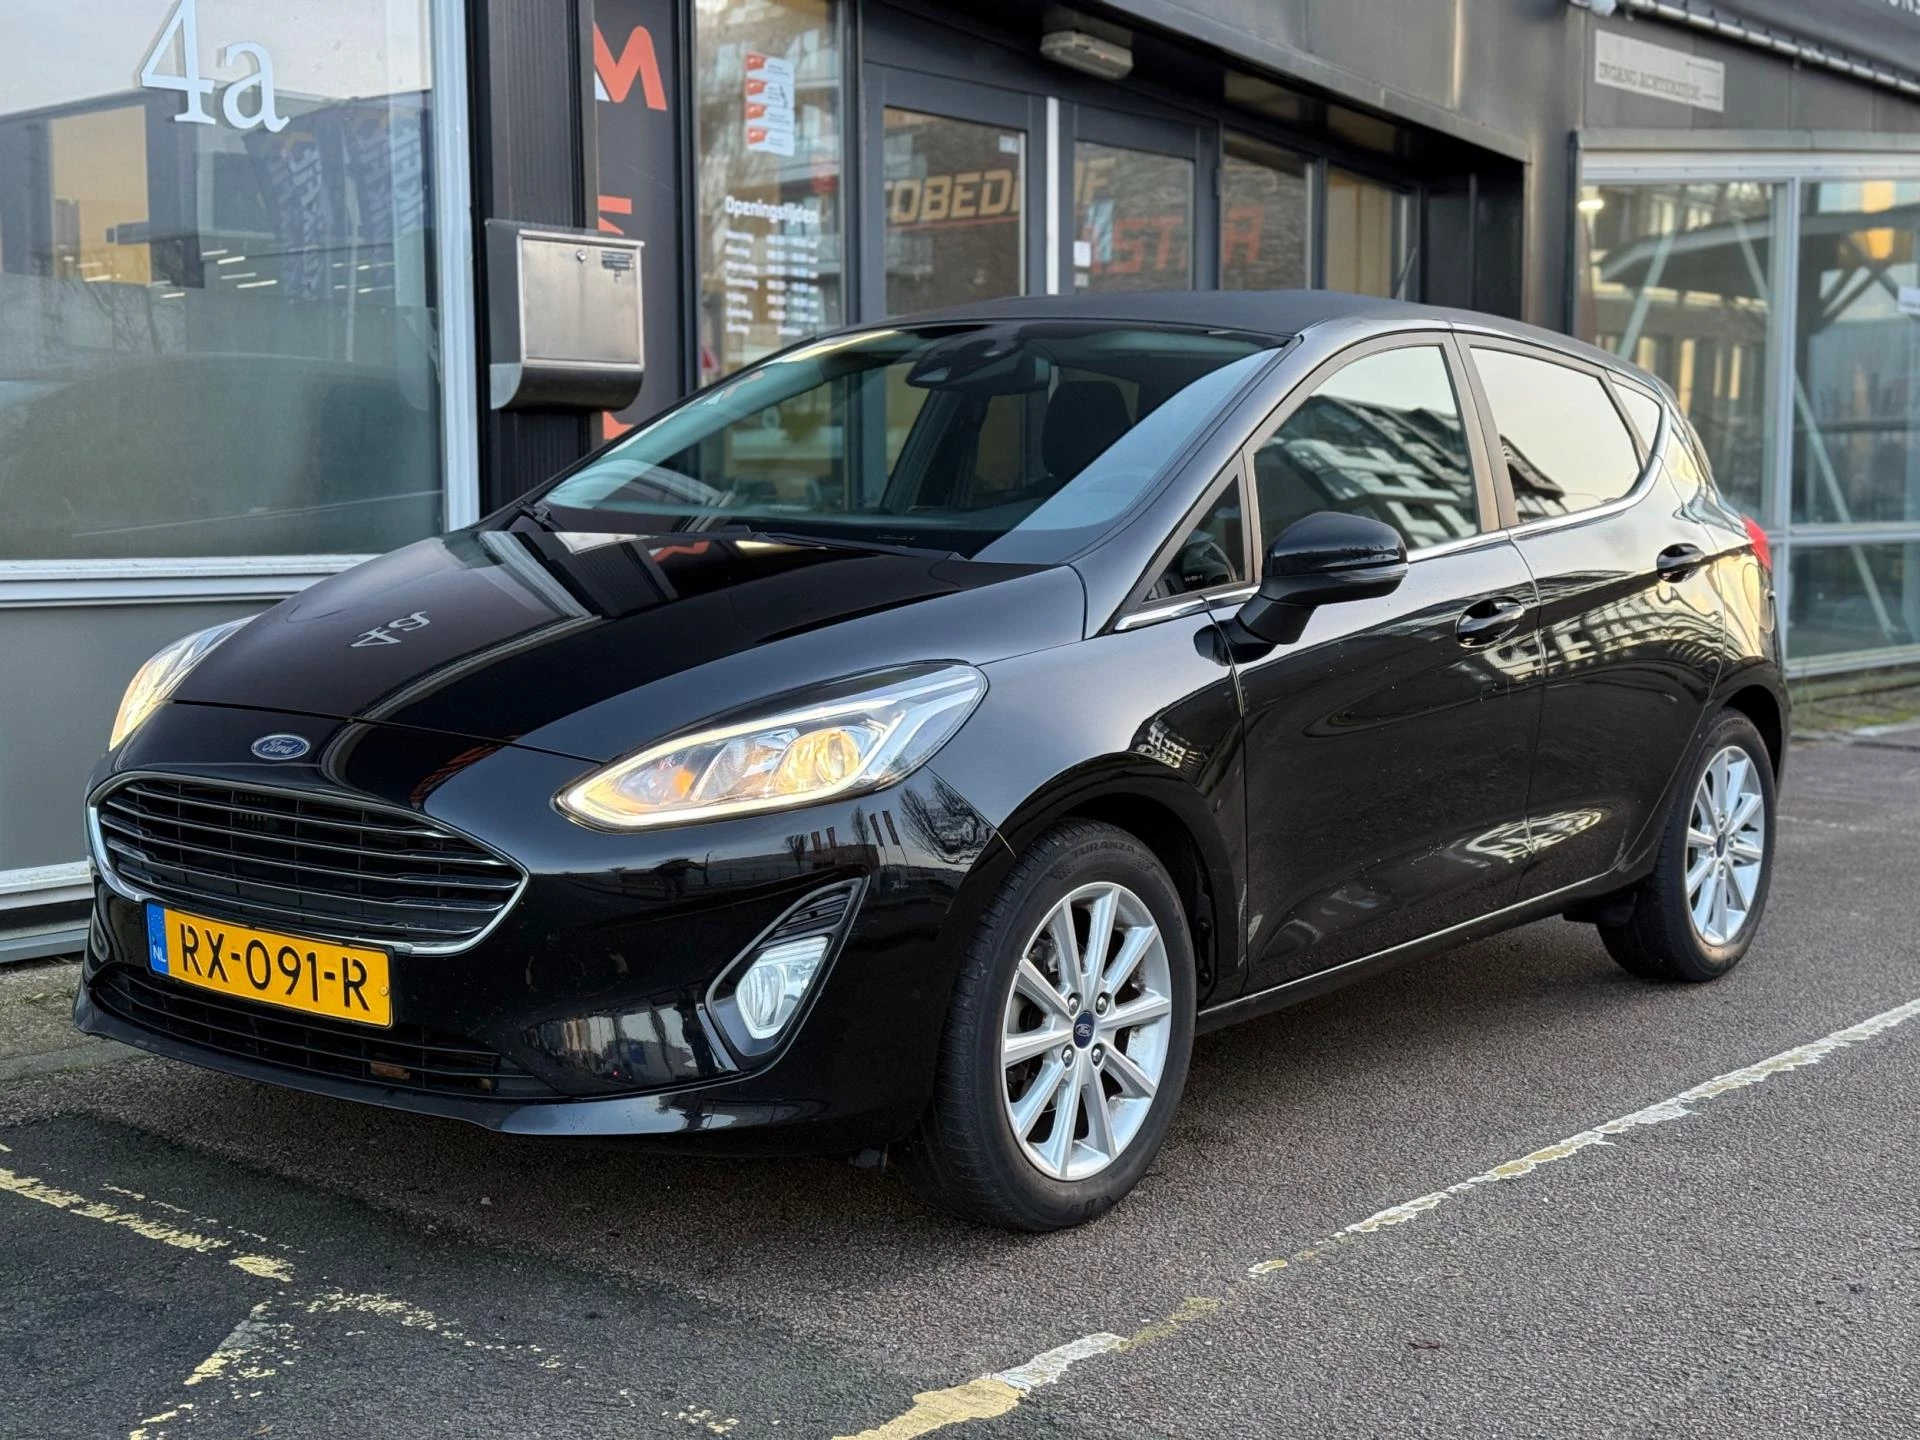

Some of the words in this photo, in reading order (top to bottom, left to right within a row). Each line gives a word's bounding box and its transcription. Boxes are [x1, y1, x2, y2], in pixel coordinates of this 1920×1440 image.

[140, 0, 290, 133] 4a
[1071, 840, 1135, 858] TURANZA
[152, 944, 166, 963] NL
[180, 923, 371, 1011] RX-091-R
